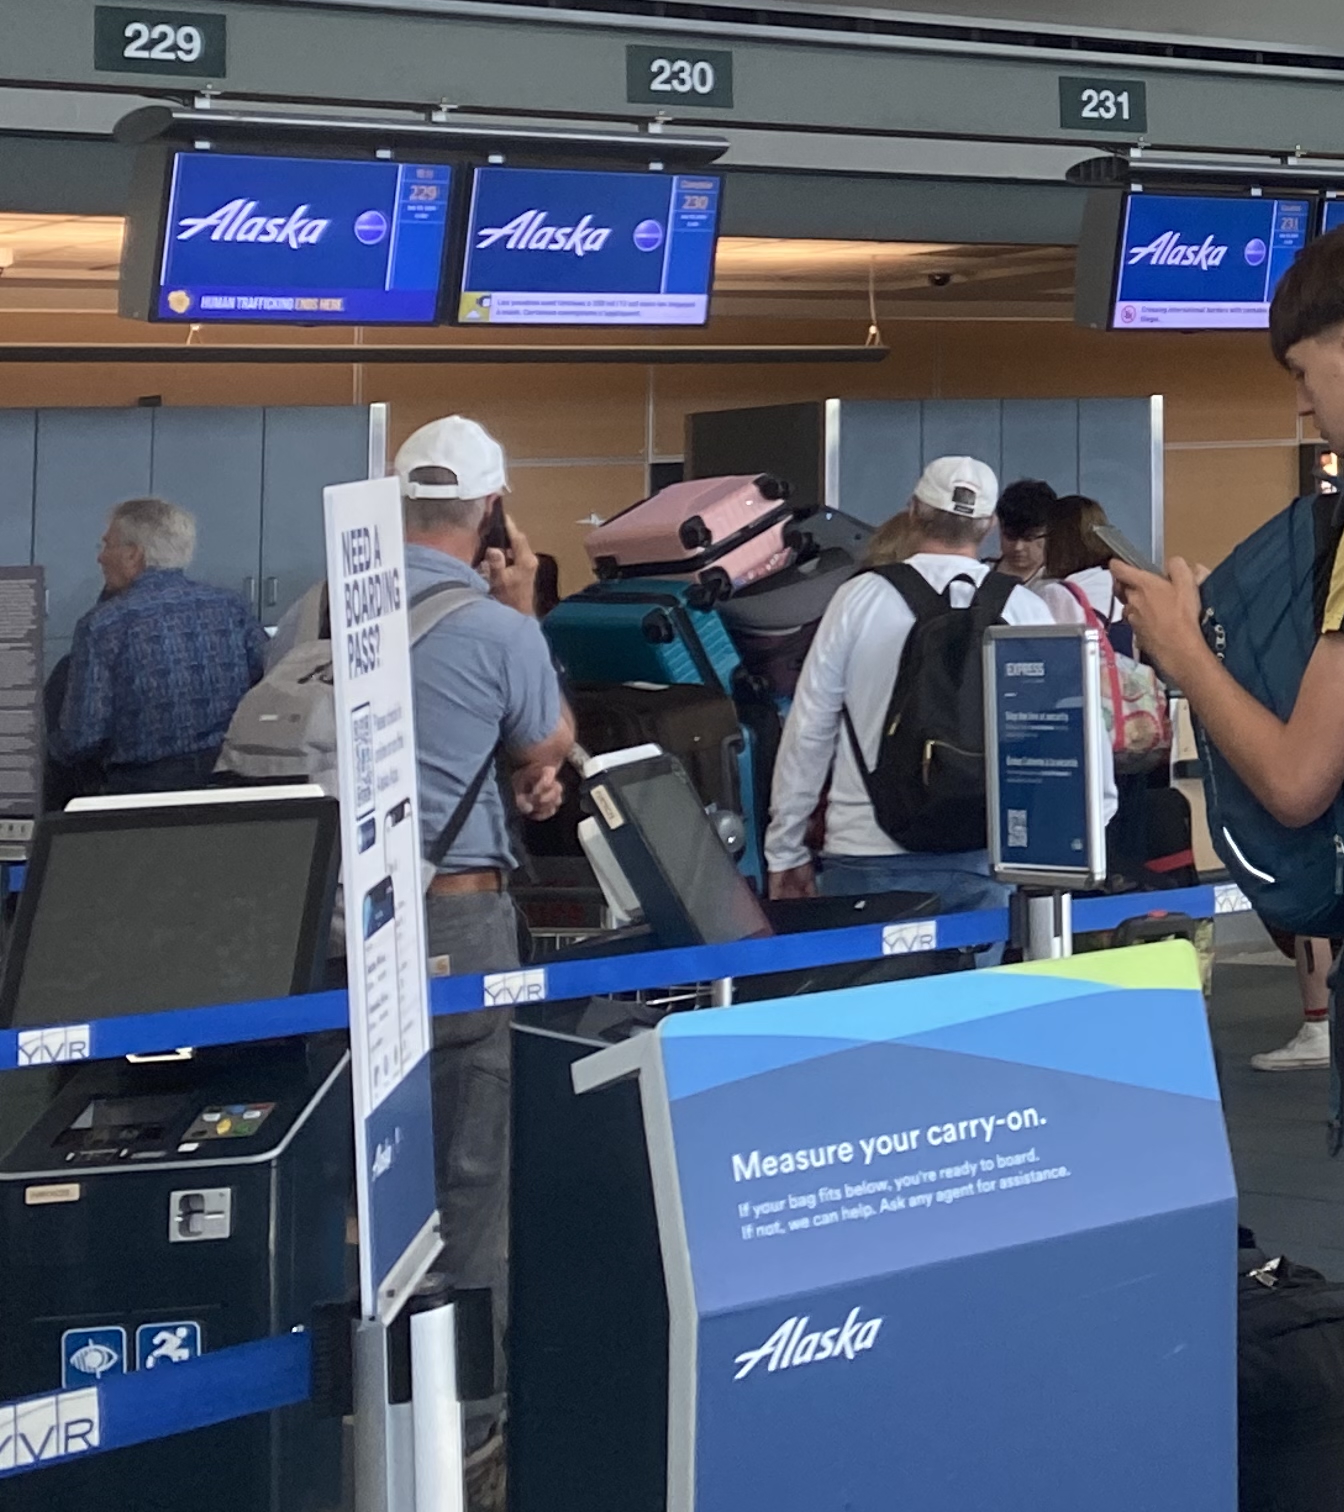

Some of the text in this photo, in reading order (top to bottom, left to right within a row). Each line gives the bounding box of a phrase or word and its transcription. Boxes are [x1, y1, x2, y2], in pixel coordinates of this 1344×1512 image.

[123, 25, 202, 62] 229
[650, 59, 714, 95] 230
[1081, 90, 1131, 120] 231
[409, 185, 438, 201] 229
[683, 195, 708, 210] 230
[177, 197, 331, 249] Alaska
[476, 209, 612, 257] Alaska
[1128, 230, 1229, 271] Alaska
[200, 296, 236, 310] HUMAN
[237, 297, 293, 311] TRAFFICKING
[342, 525, 382, 576] NEED A
[344, 568, 401, 628] BOARDING
[347, 623, 381, 680] PASS?
[883, 933, 935, 952] YVR
[485, 983, 546, 1006] YVR
[18, 1040, 89, 1065] YVR
[732, 1107, 1047, 1181] Measure your carry-on.
[738, 1147, 1040, 1218] If your bag fits below, you're ready to board.
[742, 1163, 1072, 1240] If not, we can help. Ask any agent for assistance.
[733, 1306, 884, 1381] Alaska
